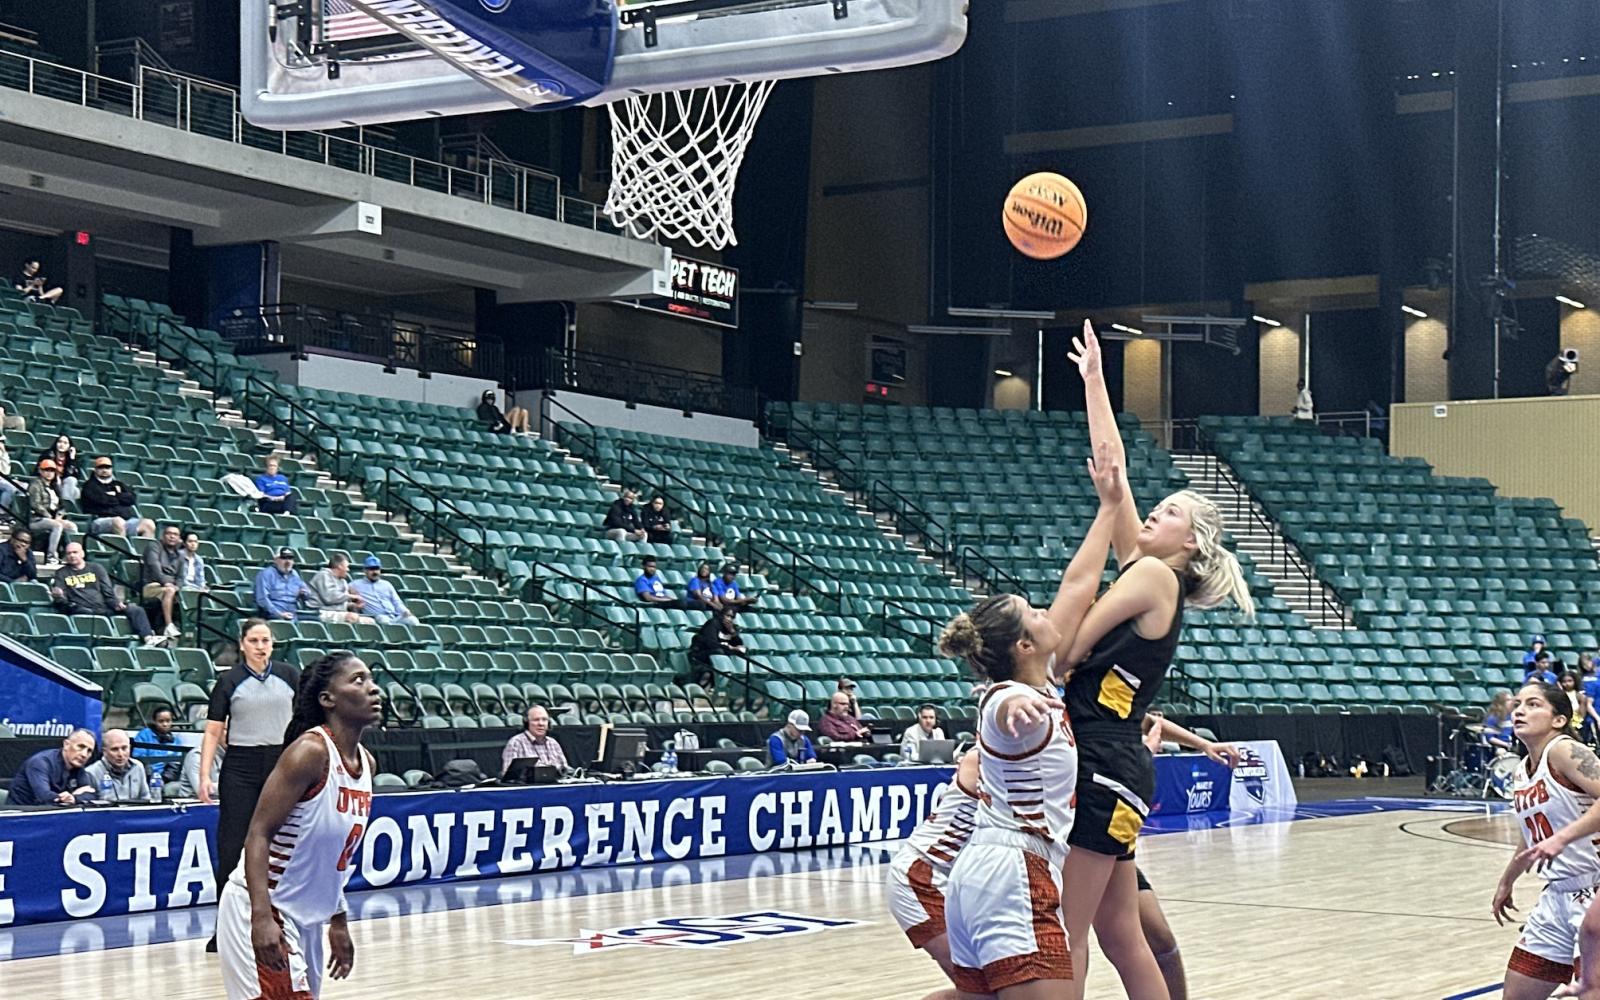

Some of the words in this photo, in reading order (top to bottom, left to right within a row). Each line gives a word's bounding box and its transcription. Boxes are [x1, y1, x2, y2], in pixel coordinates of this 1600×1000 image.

[358, 0, 526, 78] TEXLEGEN
[1012, 200, 1064, 237] Wilson
[700, 266, 736, 298] TECH
[1186, 785, 1213, 813] YOURS
[1514, 779, 1549, 813] UTPB
[61, 828, 218, 918] STA
[343, 795, 727, 888] ONFERENCE
